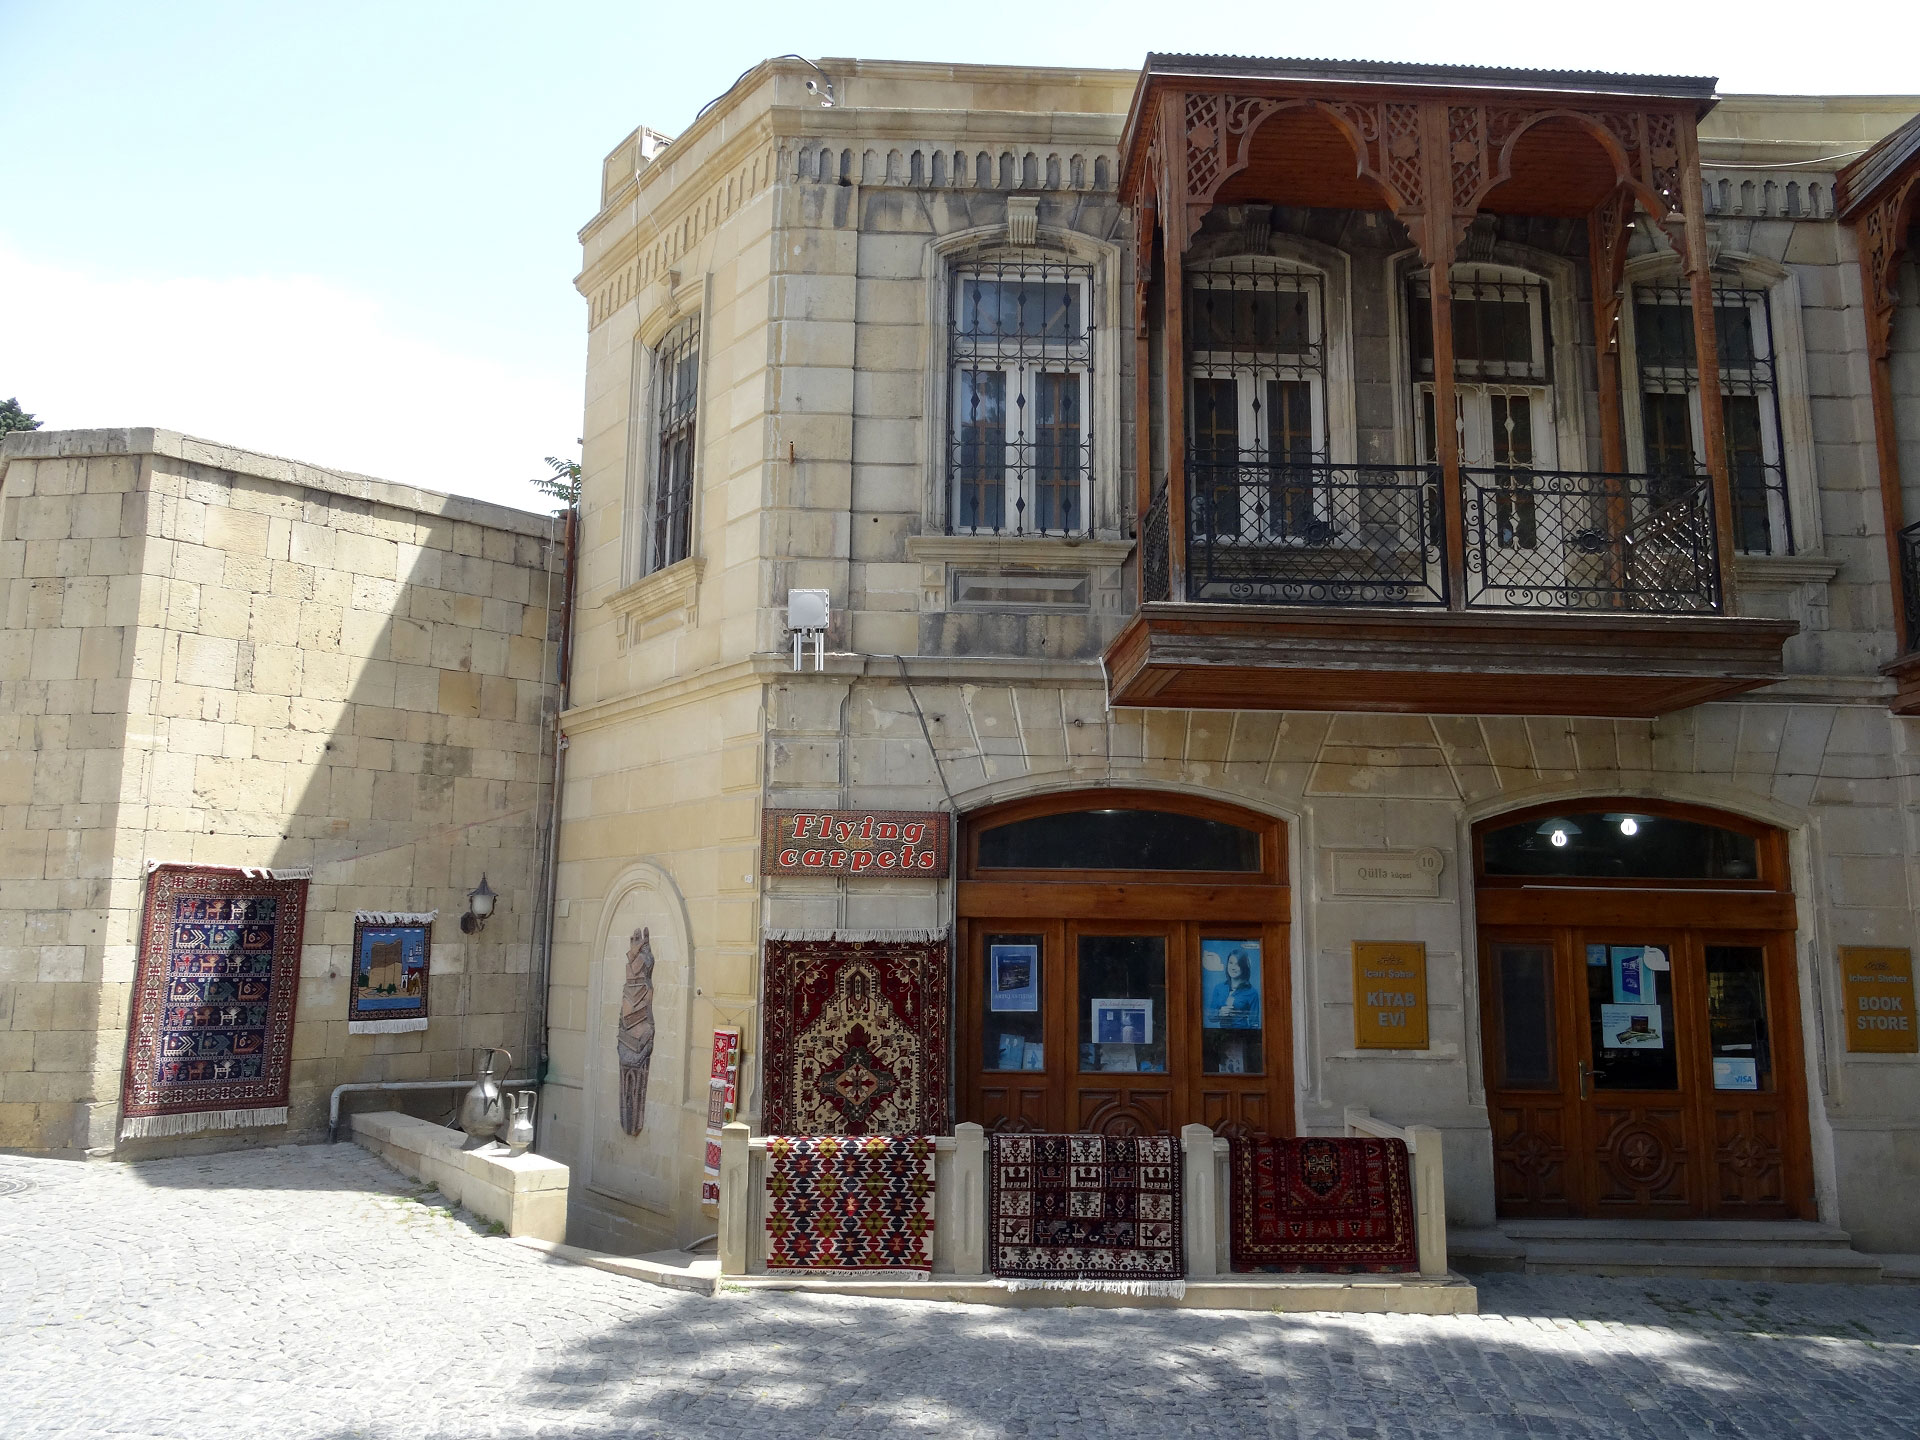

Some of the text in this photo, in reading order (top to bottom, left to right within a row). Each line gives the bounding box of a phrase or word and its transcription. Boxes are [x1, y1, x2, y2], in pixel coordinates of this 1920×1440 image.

[792, 814, 926, 843] Flying
[779, 845, 935, 872] carpets
[1422, 857, 1434, 868] 10
[1358, 867, 1388, 880] Qüllə
[1367, 990, 1415, 1007] KİTAB
[1859, 997, 1902, 1010] BOOK
[1379, 1009, 1406, 1026] EVİ
[1858, 1016, 1908, 1030] STORE
[1735, 1075, 1753, 1083] VISA
